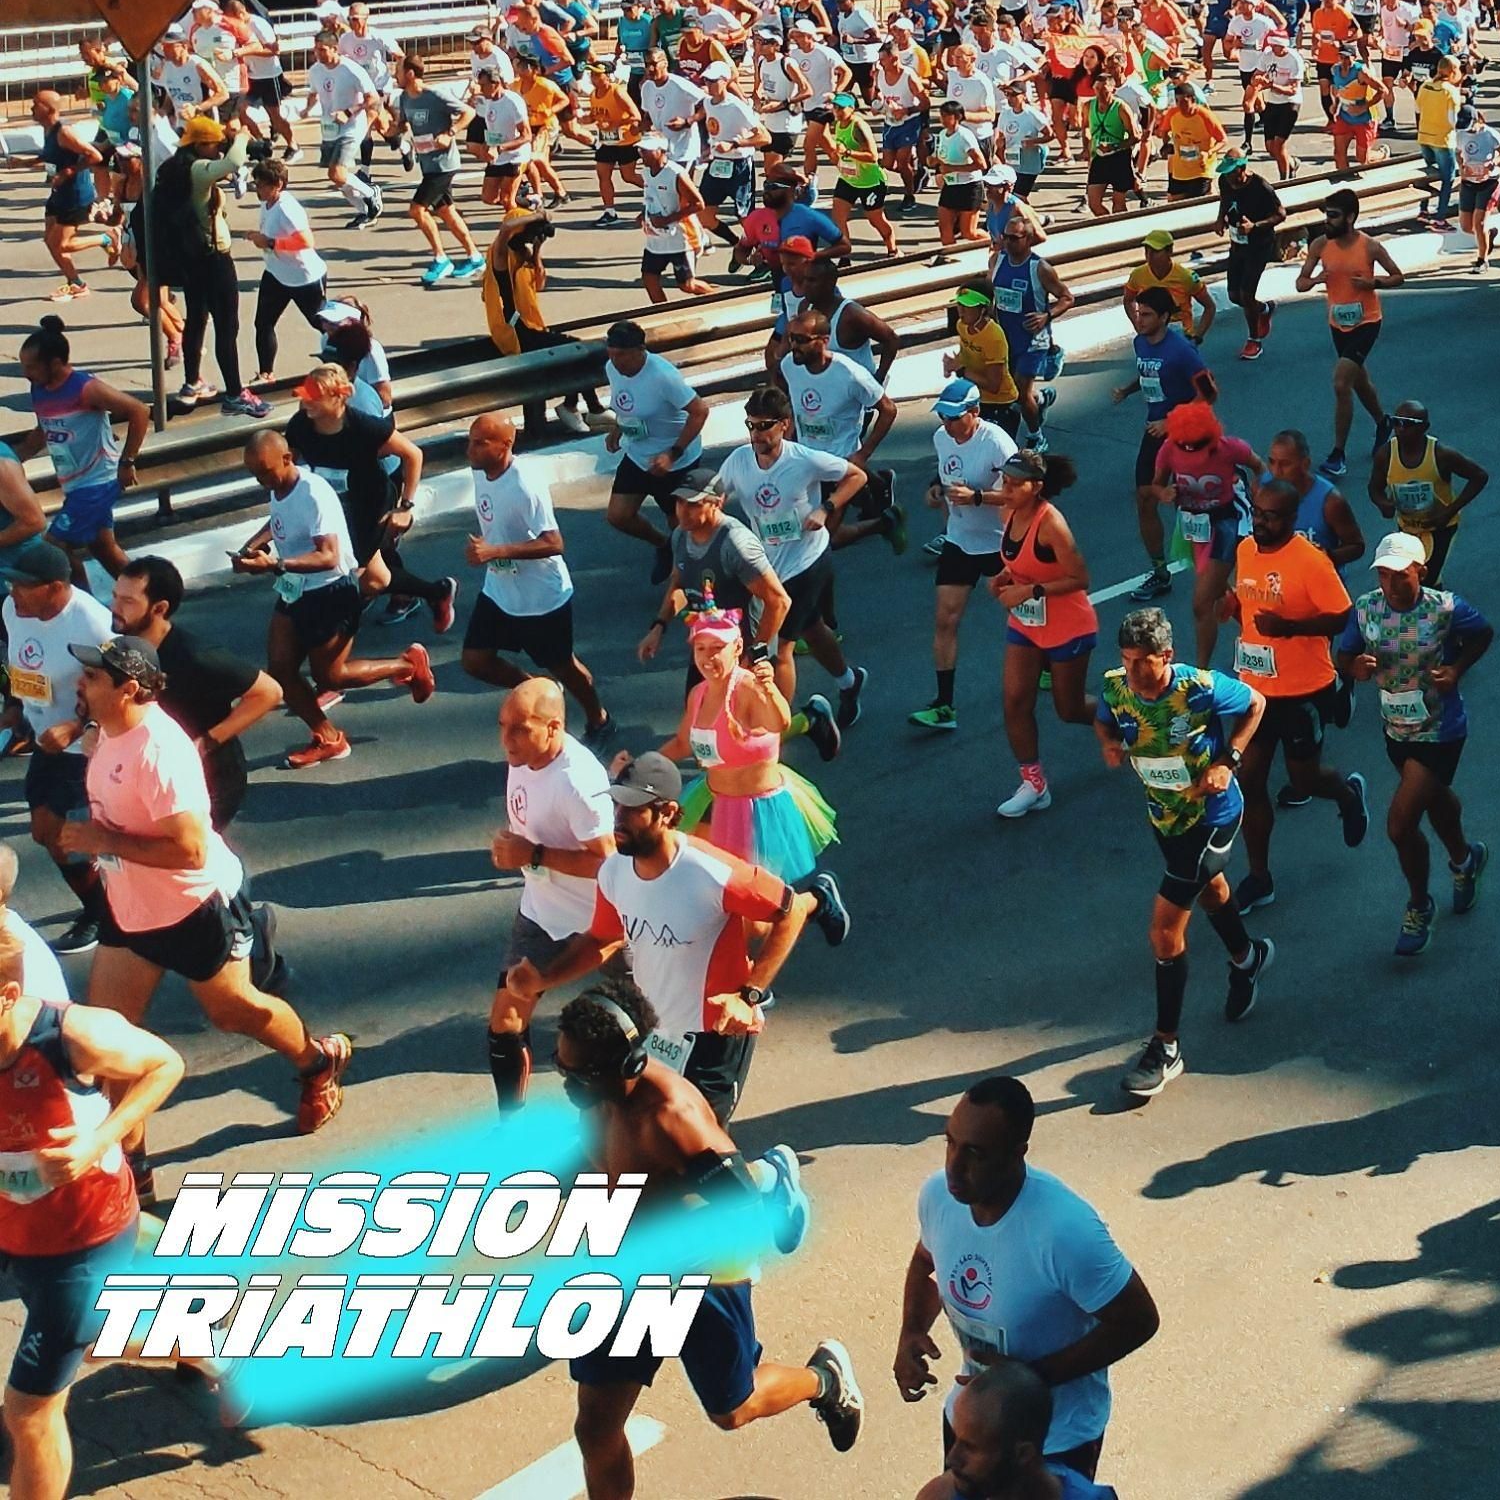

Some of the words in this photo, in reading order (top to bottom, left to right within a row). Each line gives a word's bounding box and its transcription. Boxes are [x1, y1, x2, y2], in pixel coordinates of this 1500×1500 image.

[765, 521, 792, 534] 1812
[1149, 768, 1180, 781] 4436
[651, 1034, 682, 1060] 8443
